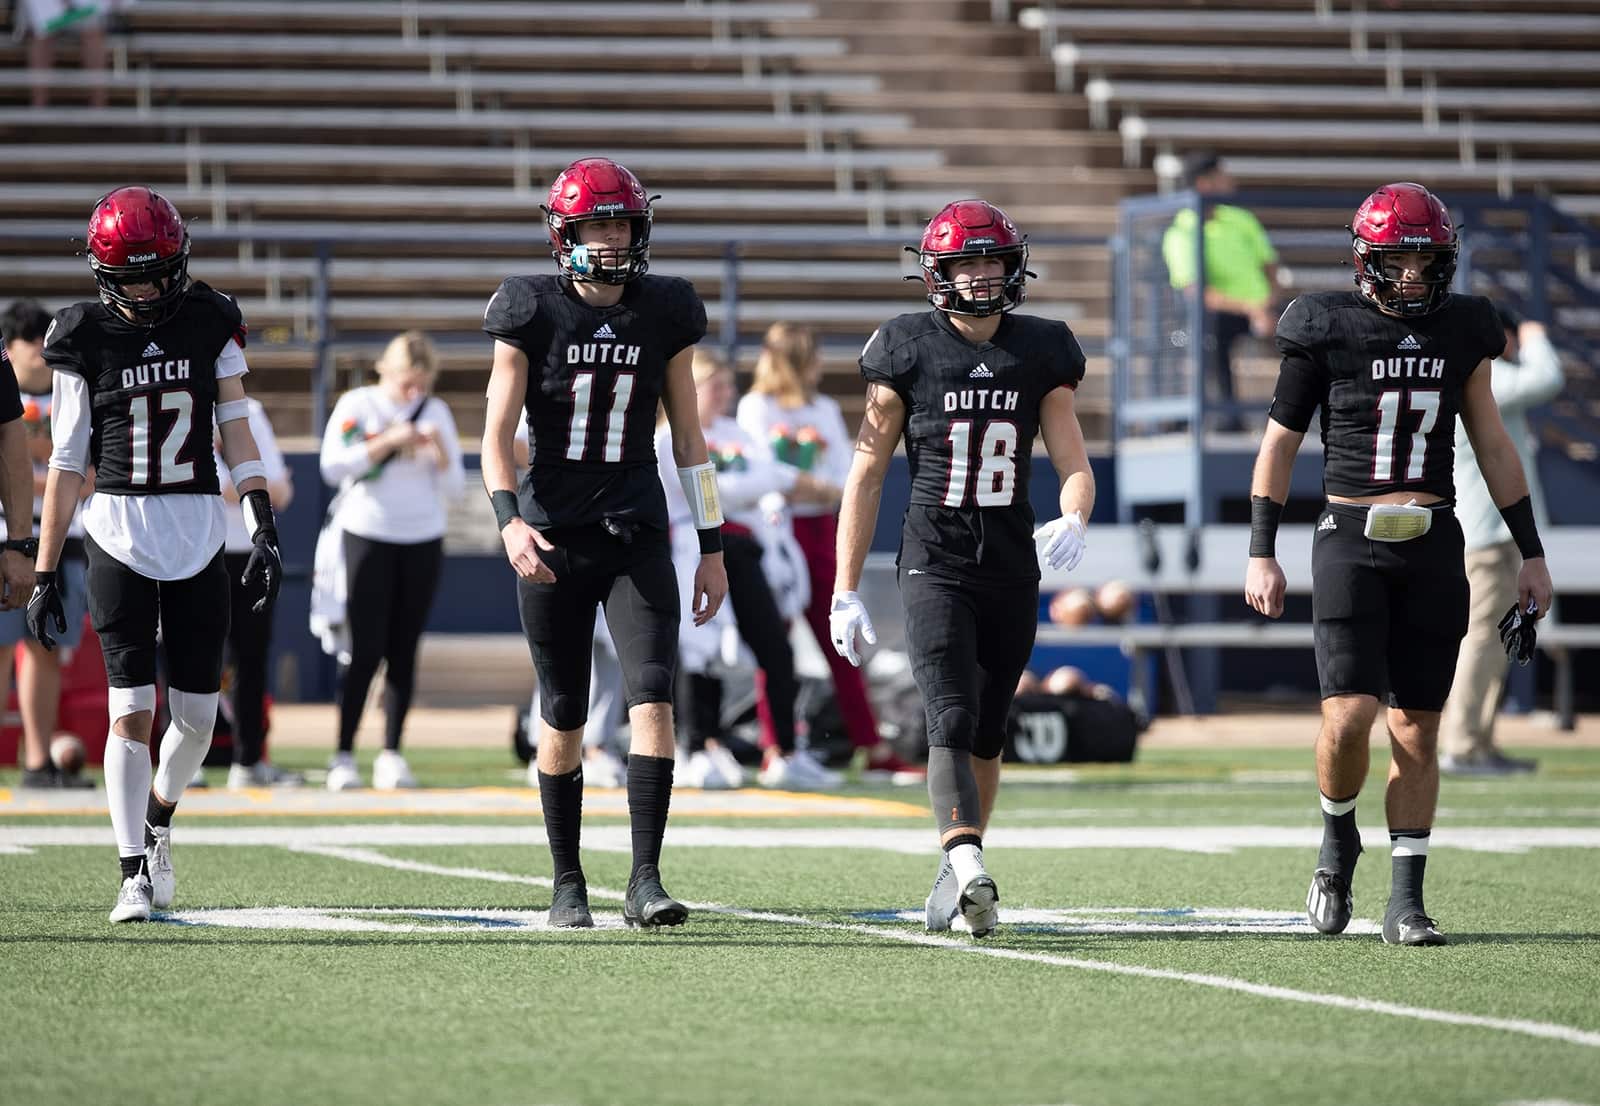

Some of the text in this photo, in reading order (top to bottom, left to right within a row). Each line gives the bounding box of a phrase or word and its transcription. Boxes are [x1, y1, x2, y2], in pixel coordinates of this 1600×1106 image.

[127, 252, 157, 263] Riddell
[567, 343, 641, 366] DUTCH
[1372, 357, 1445, 380] DUTCH
[121, 359, 190, 389] DUTCH
[944, 389, 1019, 412] DUTCH
[565, 372, 637, 463] 11
[128, 390, 195, 487] 12
[1372, 390, 1442, 482] 17
[942, 420, 1019, 508] 18
